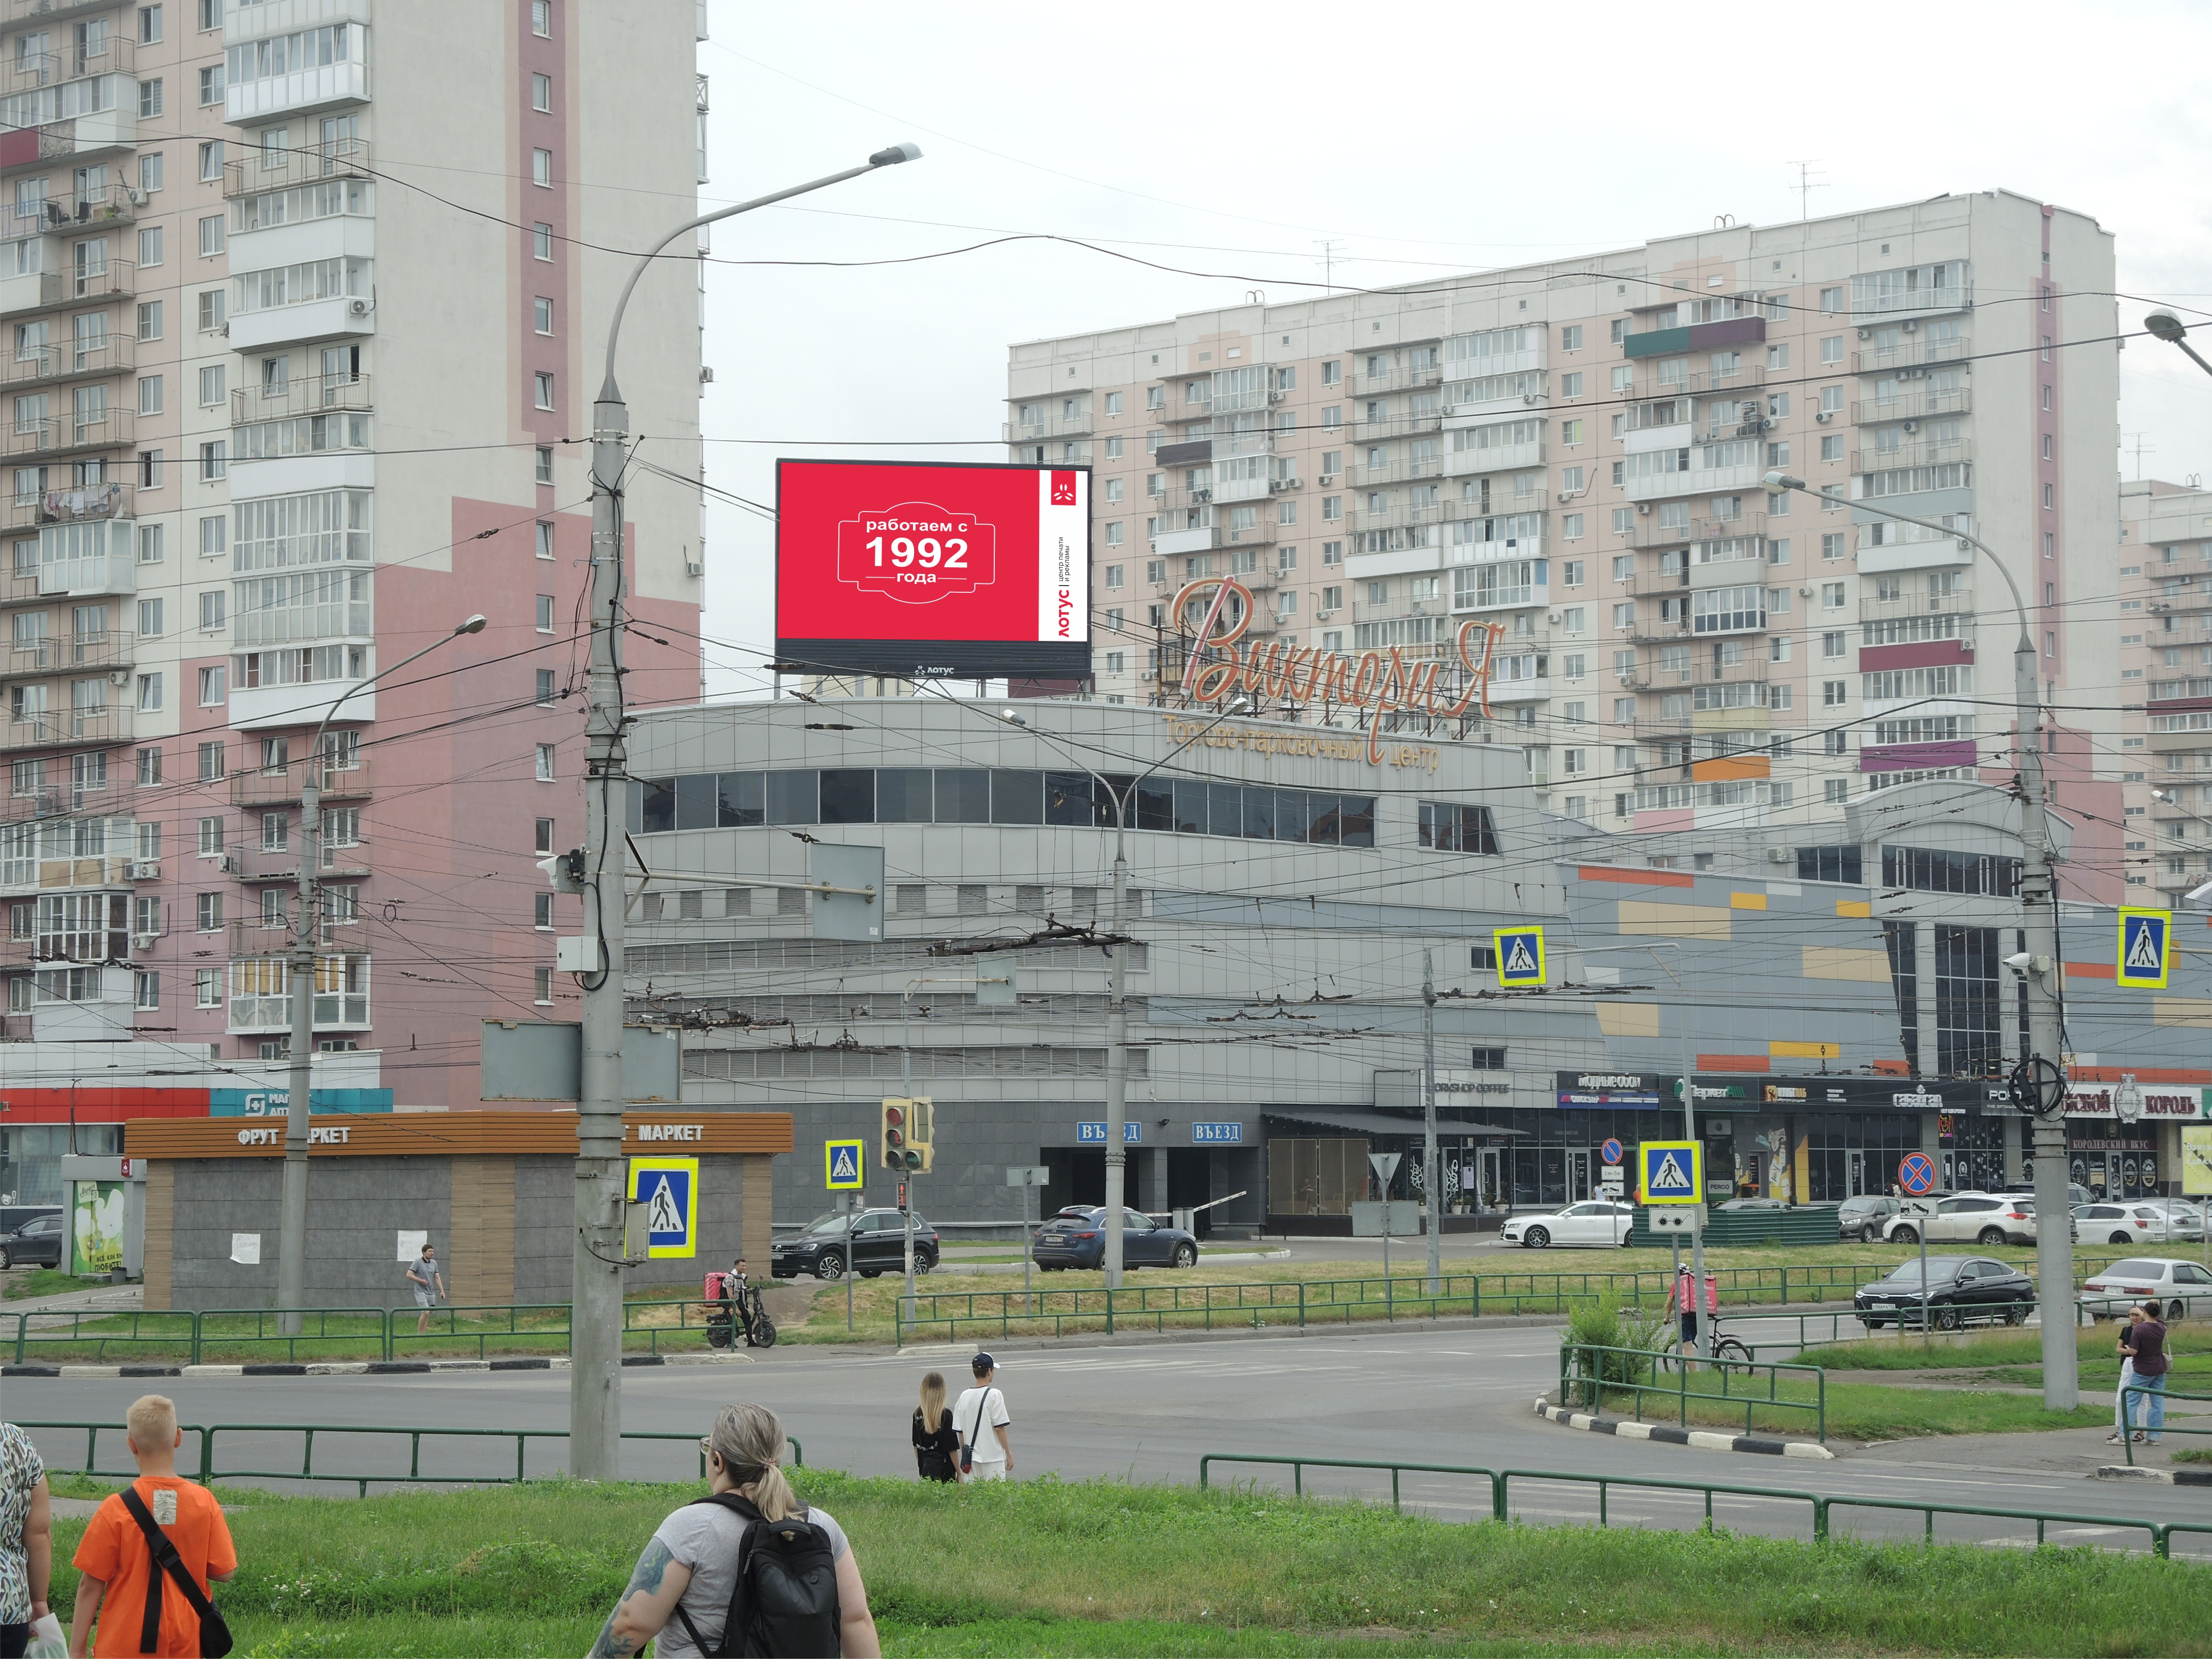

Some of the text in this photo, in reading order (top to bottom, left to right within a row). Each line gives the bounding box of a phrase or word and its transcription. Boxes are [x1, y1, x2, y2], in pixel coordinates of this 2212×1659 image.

[866, 518, 968, 533] работаем с
[865, 536, 968, 568] 1992
[897, 572, 937, 585] года
[1163, 714, 1440, 775] Торгово-парковочный центр
[1434, 1083, 1510, 1093] ORKSHOP COFFEE
[2145, 1095, 2196, 1114] КОРОЛЬ
[238, 1127, 351, 1145] ФРУТ РКЕТ
[638, 1125, 704, 1141] МАРКЕТ
[1082, 1125, 1138, 1141] ВЪД
[1196, 1125, 1239, 1141] ВЪЕЗД
[2073, 1139, 2148, 1149] КОРОЛЕВСКИЙ ВКУС
